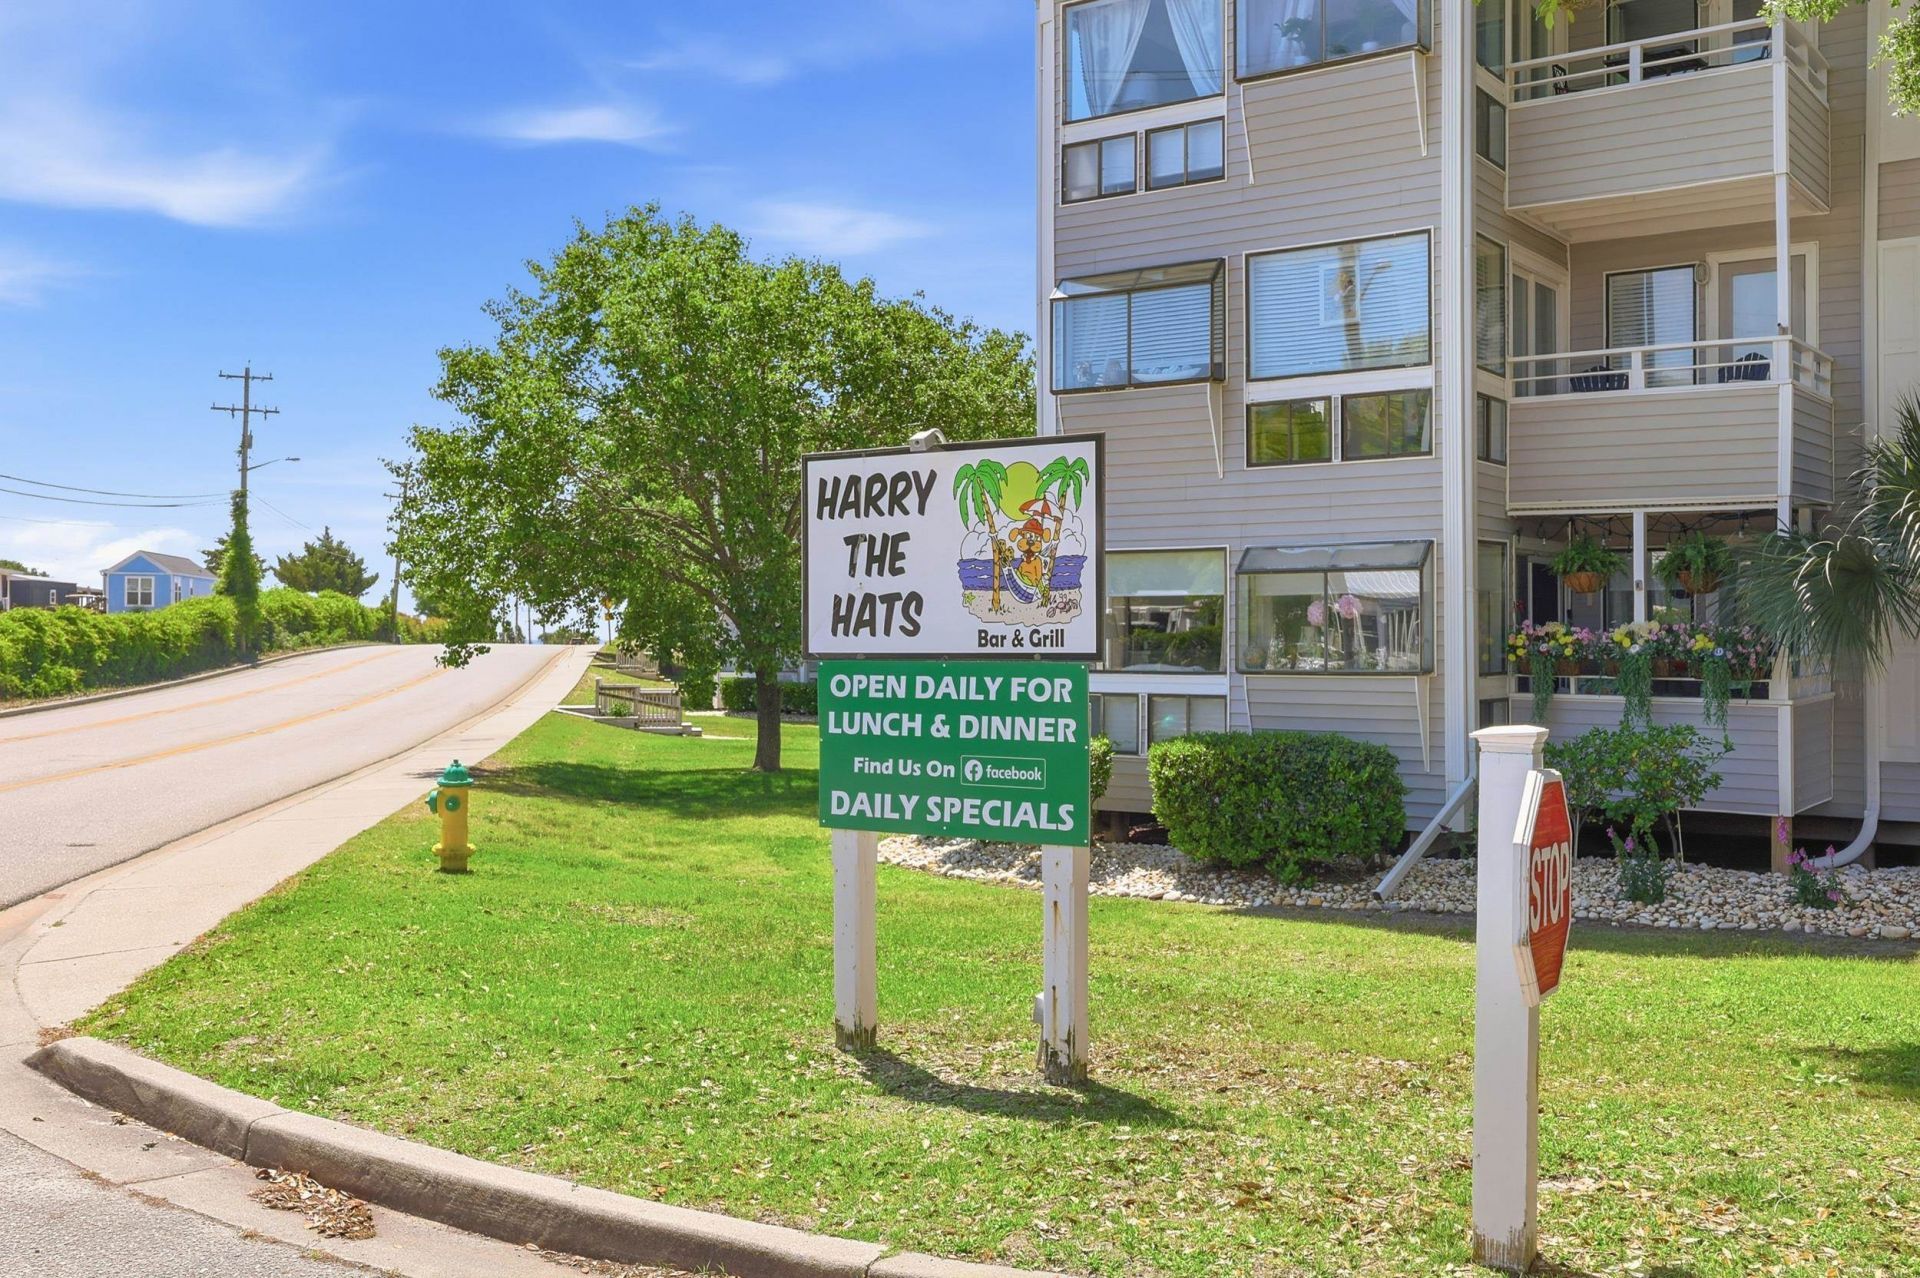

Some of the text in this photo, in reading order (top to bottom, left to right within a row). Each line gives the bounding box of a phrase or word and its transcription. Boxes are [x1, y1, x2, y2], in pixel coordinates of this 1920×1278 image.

[816, 469, 938, 520] HARRY
[843, 531, 911, 578] THE
[831, 590, 924, 637] HATS
[977, 628, 1065, 648] Bar & Grill
[830, 674, 1073, 703] OPEN DAILY FOR
[828, 711, 1077, 743] LUNCH & DINNER
[853, 757, 893, 775] Find
[898, 759, 921, 777] Us
[926, 760, 955, 778] On
[986, 764, 1042, 781] facebook
[831, 790, 1074, 832] DAILY SPECIALS
[1530, 841, 1570, 934] STOP
